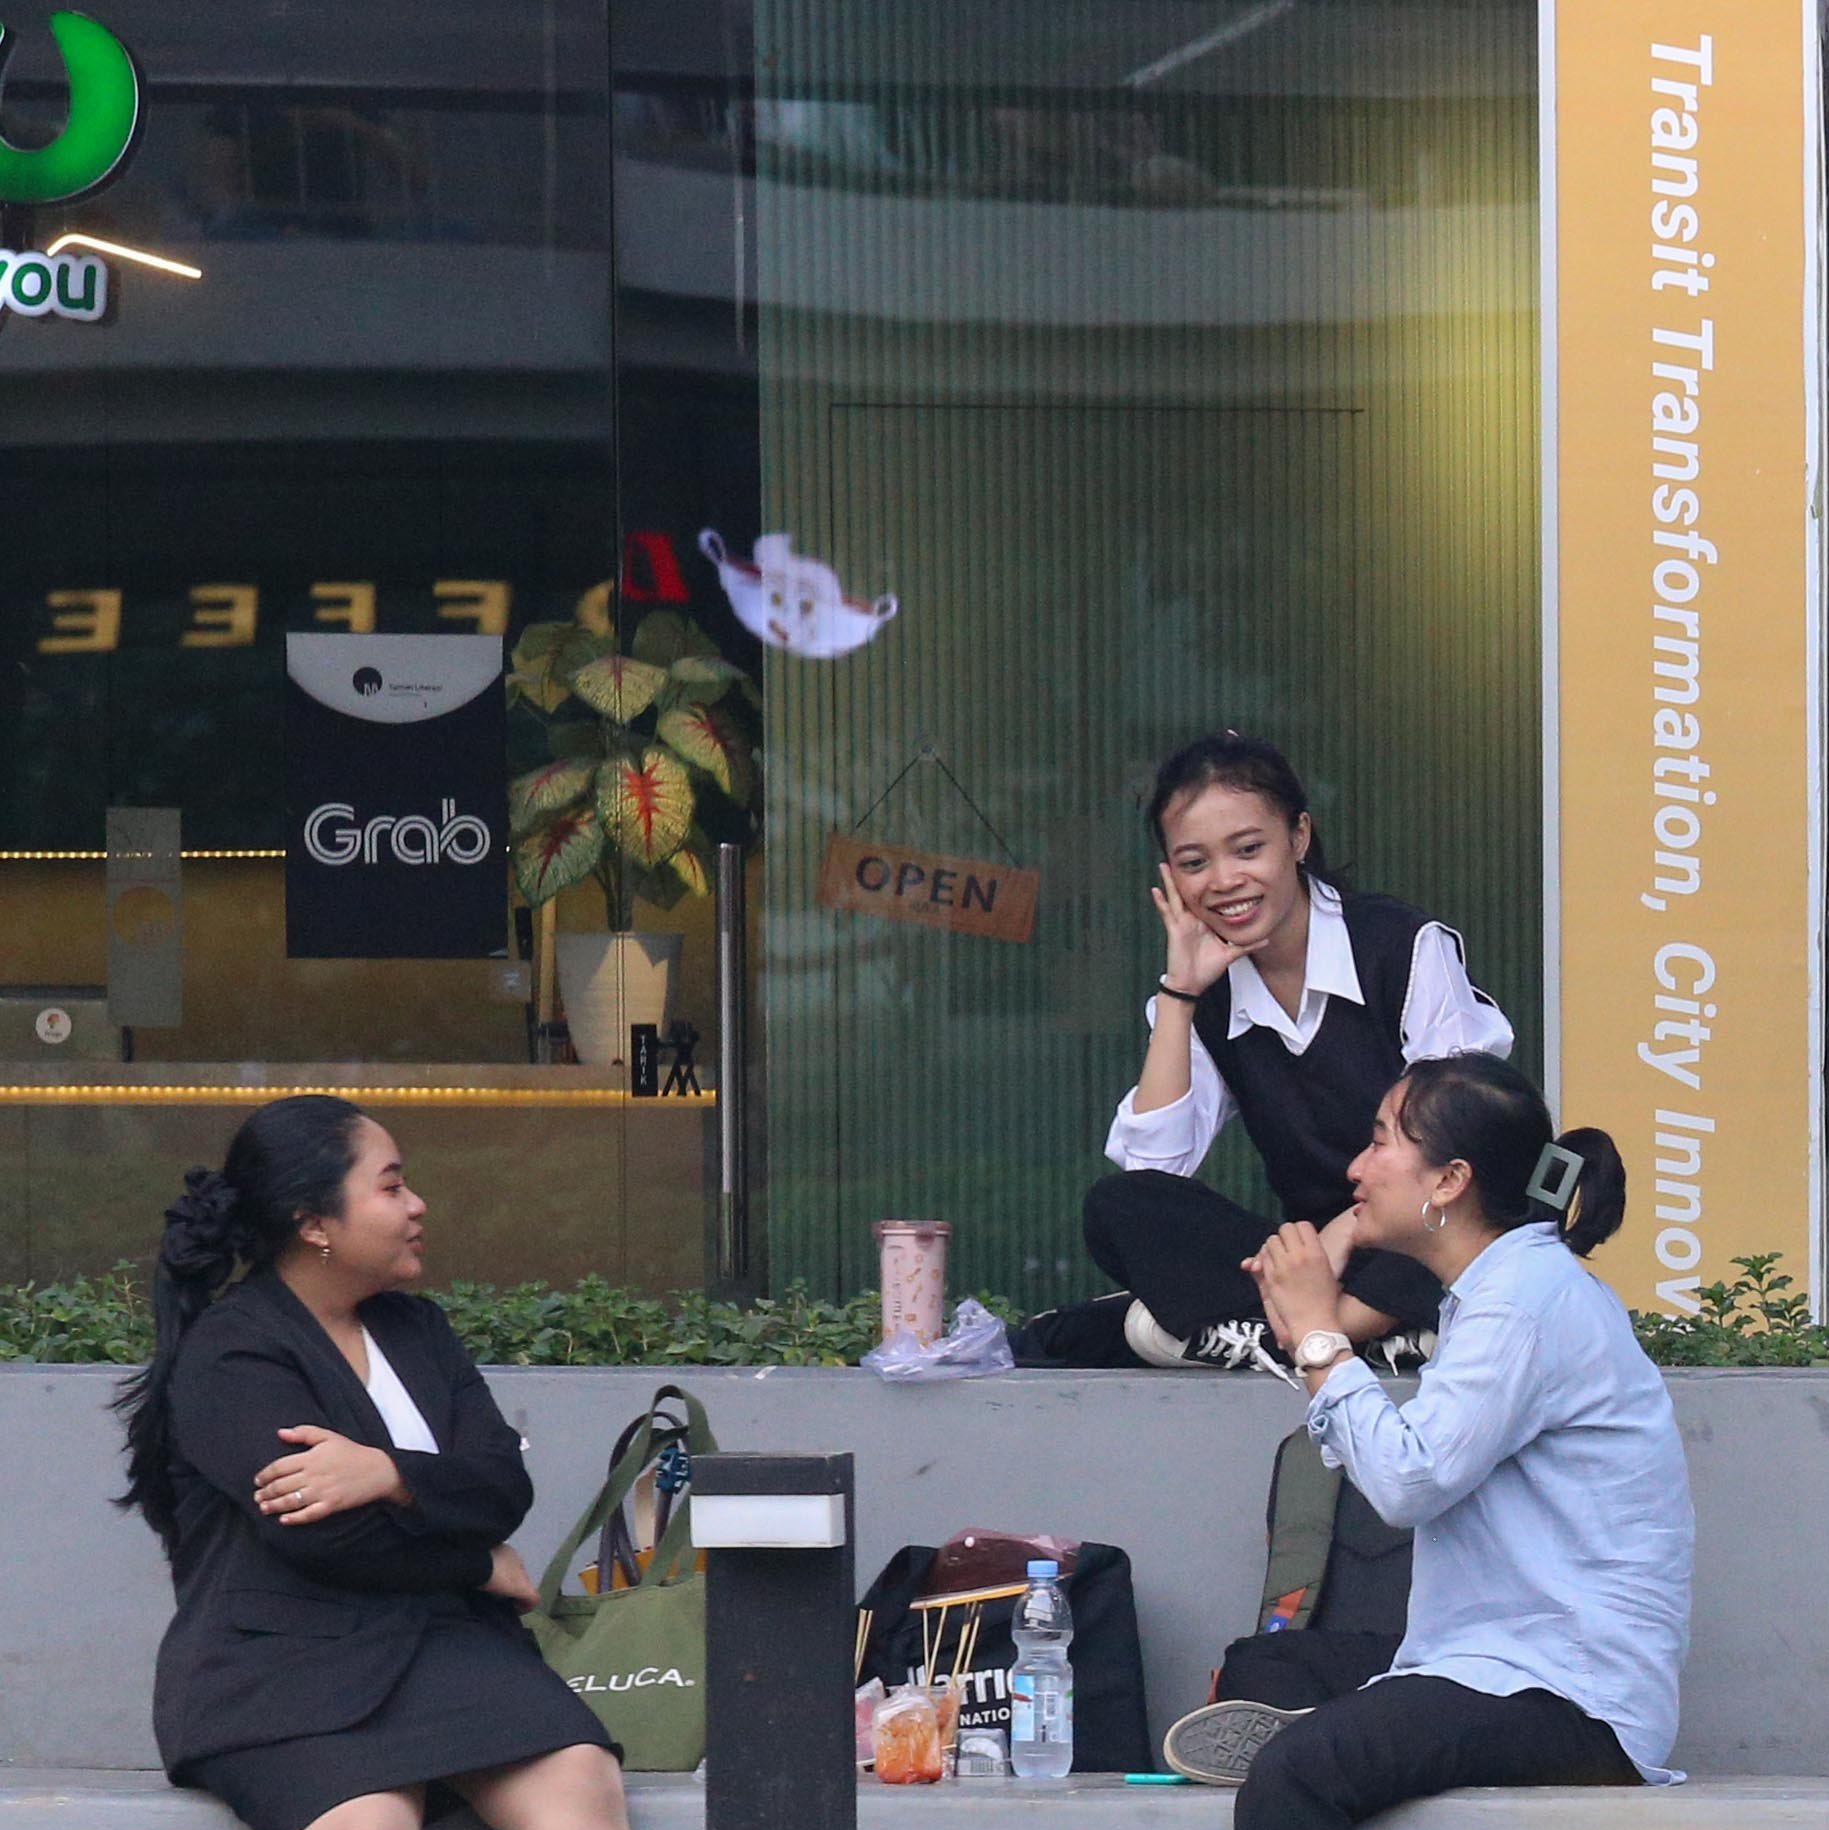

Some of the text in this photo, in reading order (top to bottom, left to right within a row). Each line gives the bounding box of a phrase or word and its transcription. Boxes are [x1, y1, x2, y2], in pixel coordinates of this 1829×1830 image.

[1650, 34, 1715, 297] Transit
[0, 259, 97, 311] ou
[1640, 319, 1717, 912] Transformation,
[304, 798, 491, 866] Grab
[856, 855, 998, 913] OPEN
[1637, 942, 1717, 1090] City
